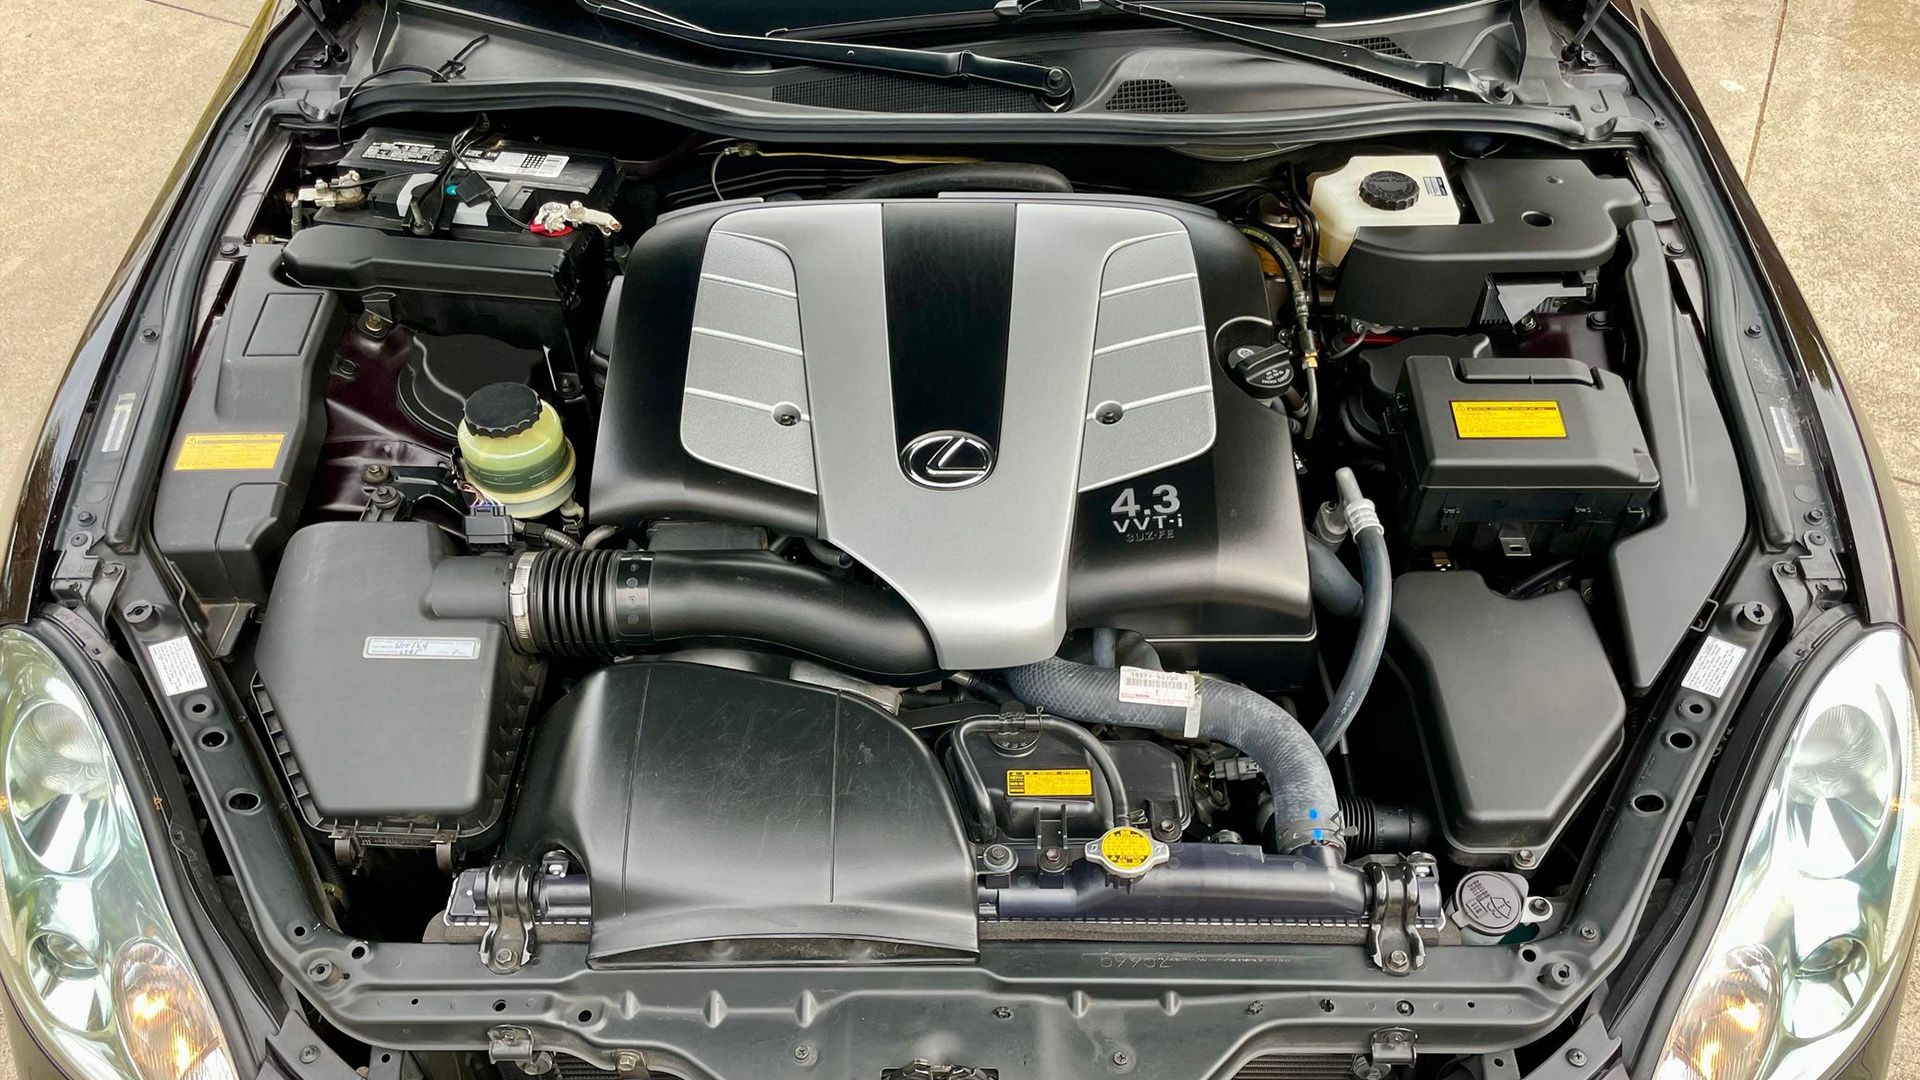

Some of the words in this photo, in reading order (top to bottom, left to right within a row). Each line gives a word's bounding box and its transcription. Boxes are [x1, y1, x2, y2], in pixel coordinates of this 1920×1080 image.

[1110, 484, 1180, 517] 4.3
[1112, 513, 1183, 533] VVT-i
[1126, 530, 1174, 543] 3UZ-FE
